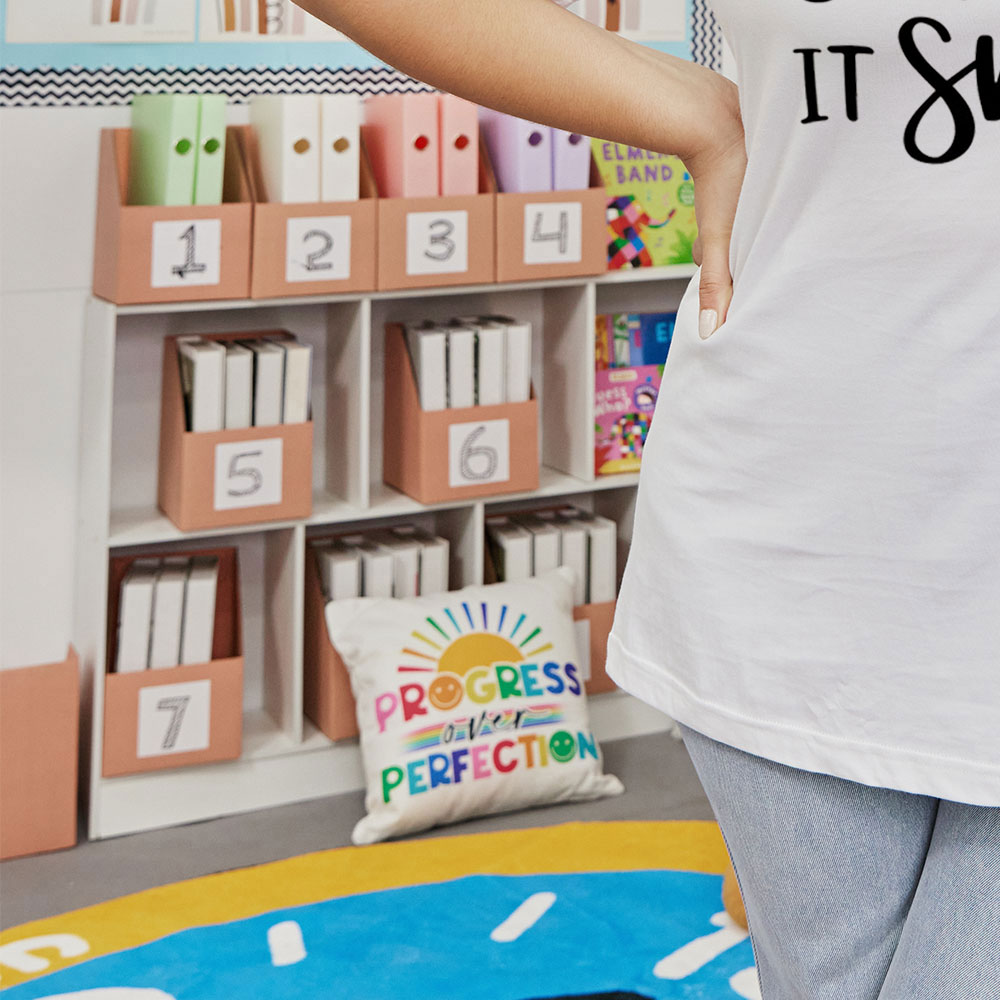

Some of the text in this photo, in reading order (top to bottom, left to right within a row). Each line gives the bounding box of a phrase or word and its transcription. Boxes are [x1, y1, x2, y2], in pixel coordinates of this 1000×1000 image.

[792, 45, 874, 124] IT
[615, 164, 674, 184] BAND
[172, 224, 207, 277] 1
[303, 229, 334, 271] 2
[424, 219, 456, 261] 3
[531, 211, 568, 254] 4
[226, 450, 263, 497] 5
[460, 426, 498, 481] 6
[374, 662, 582, 733] PROGRESS
[155, 696, 191, 750] 7
[442, 707, 530, 745] over
[381, 730, 599, 804] PERFECTION
